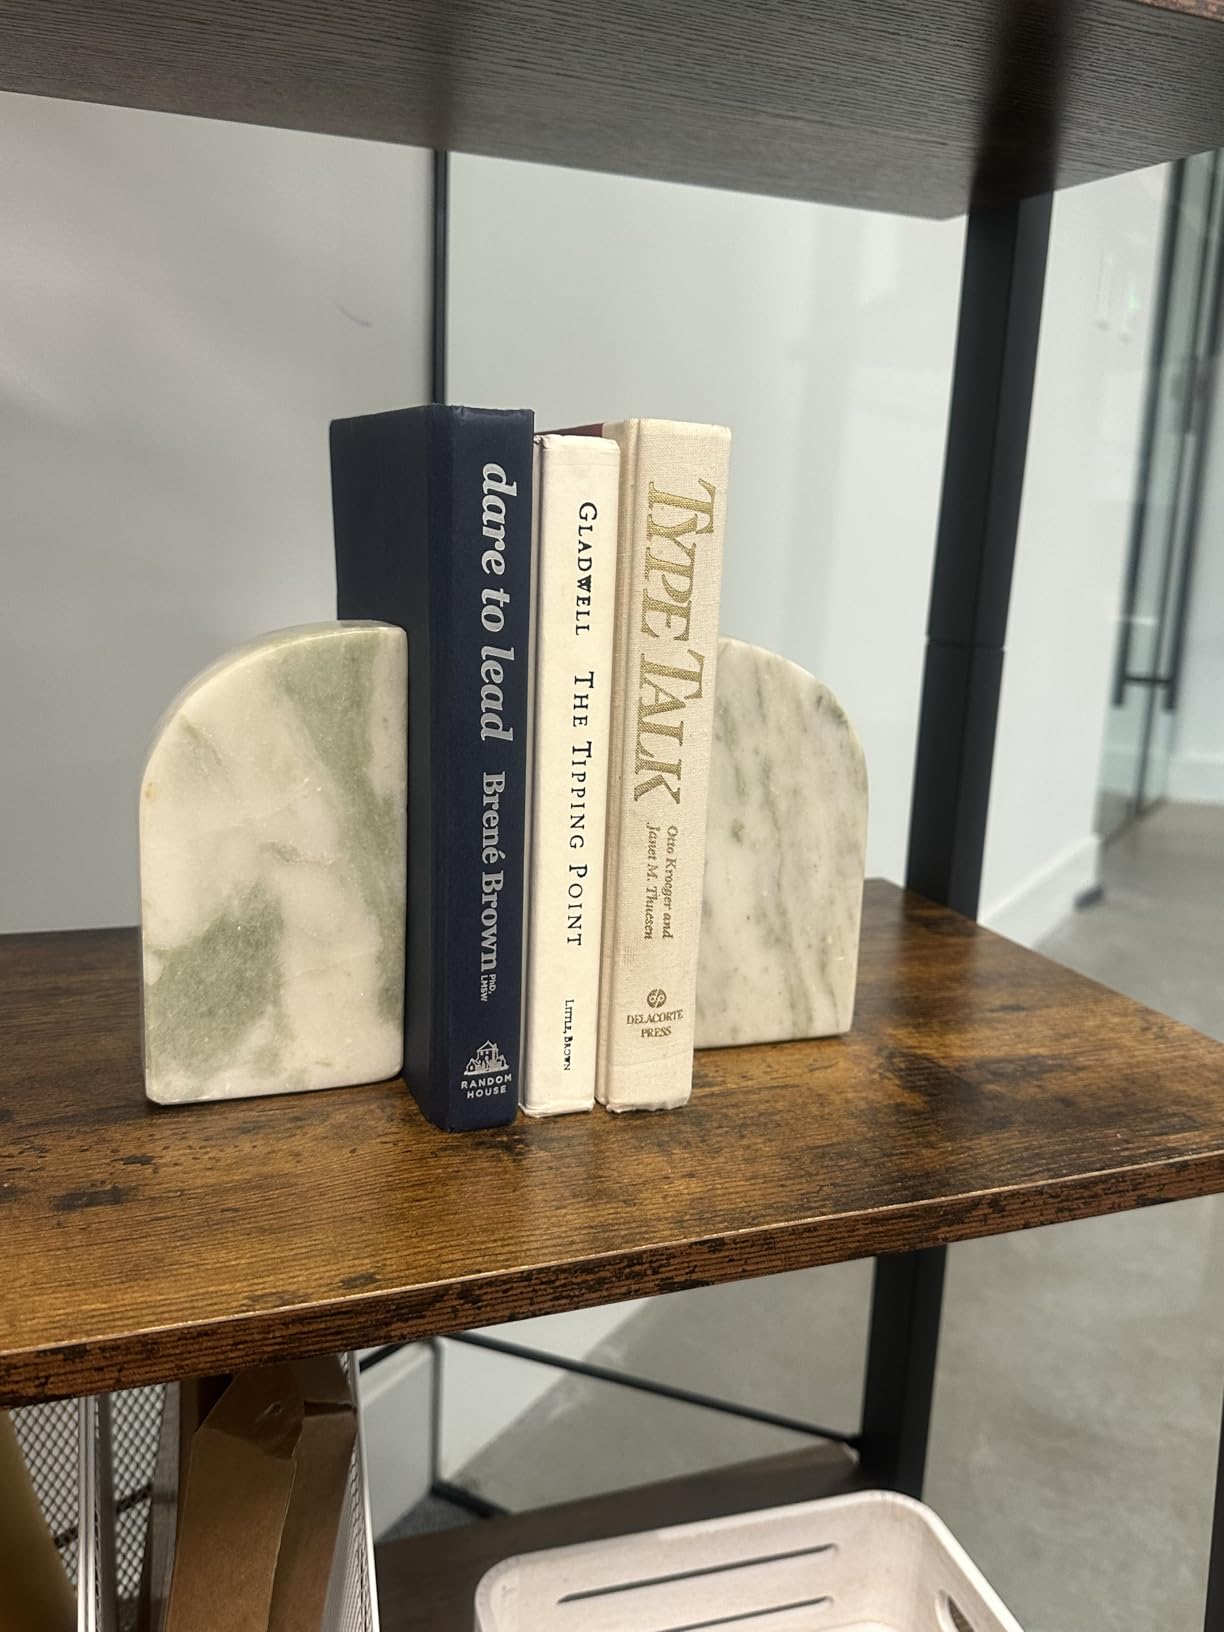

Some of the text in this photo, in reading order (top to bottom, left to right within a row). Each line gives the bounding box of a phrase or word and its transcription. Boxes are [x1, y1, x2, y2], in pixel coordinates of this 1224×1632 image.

[480, 463, 517, 741] dare to lead
[575, 502, 598, 635] GLADWELL
[634, 478, 716, 804] TYPE TALK
[567, 671, 595, 946] THE TIPPING POINT
[480, 772, 506, 970] Brené Brown
[644, 822, 661, 940] Janet M. Thuesen
[662, 825, 679, 939] Otto Kroeger and
[480, 975, 488, 1002] LMSW
[488, 974, 497, 995] PhD,
[626, 1009, 683, 1025] DELACORTE
[640, 1026, 672, 1038] PRESS
[461, 1073, 512, 1089] RANDOM
[466, 1085, 507, 1099] HOUSE
